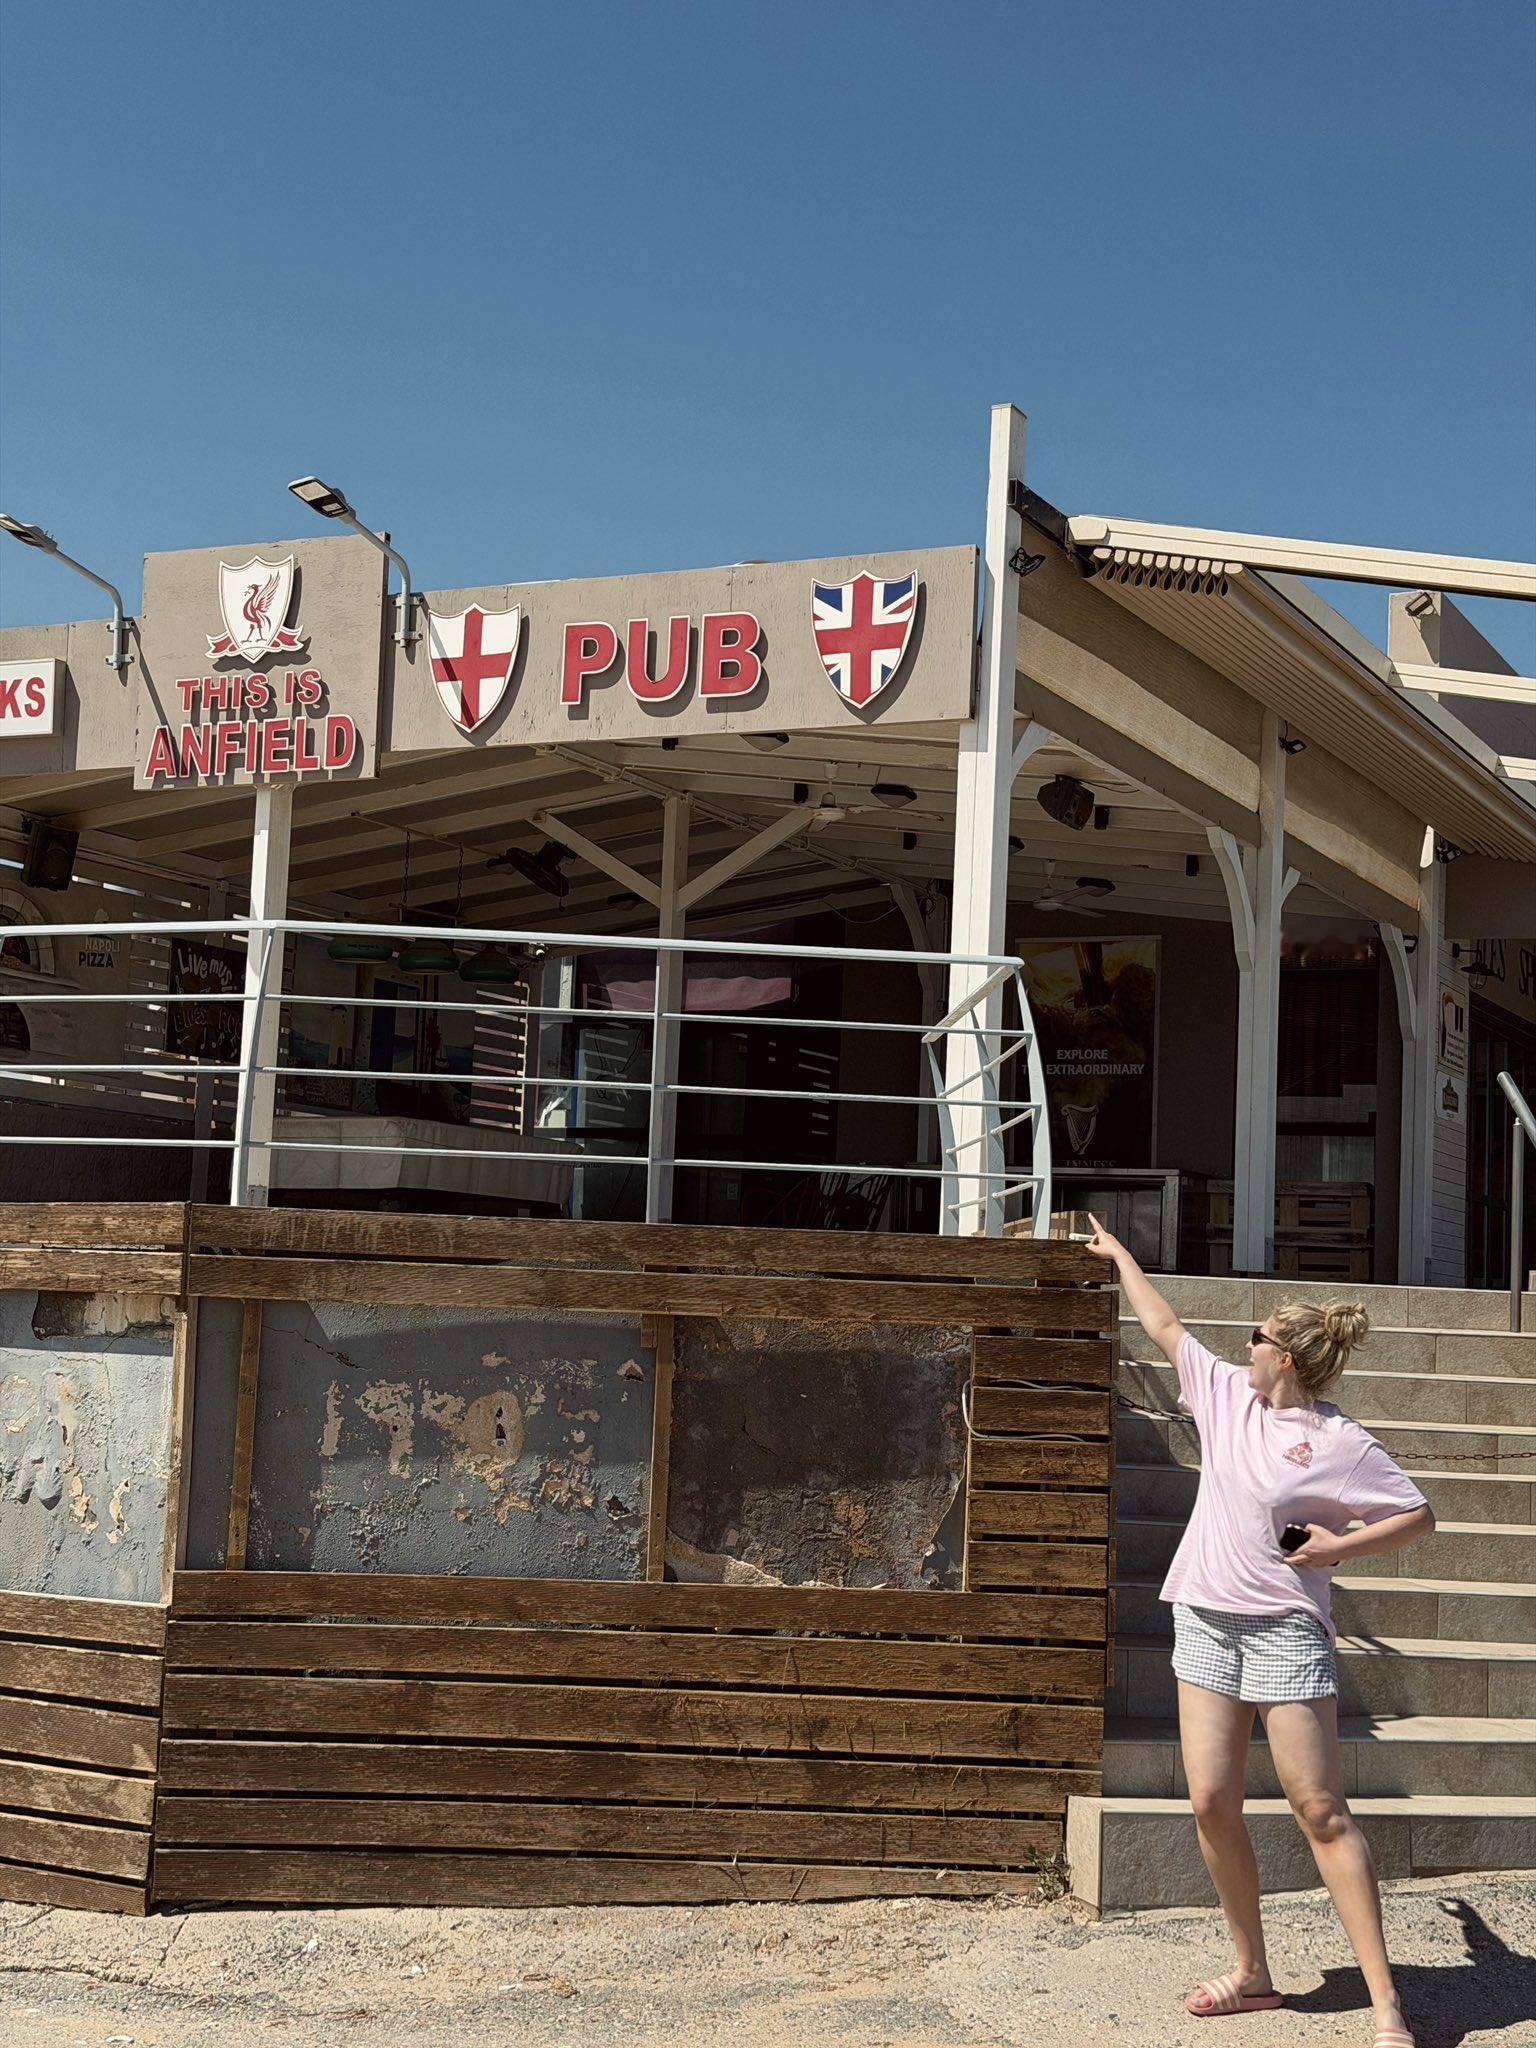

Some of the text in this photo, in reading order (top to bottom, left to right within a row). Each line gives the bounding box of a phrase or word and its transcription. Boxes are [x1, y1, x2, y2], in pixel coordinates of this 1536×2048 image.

[561, 611, 764, 706] PUB
[176, 669, 322, 711] THIS IS
[144, 714, 356, 779] ANFIELD
[79, 951, 114, 968] PIZZA
[85, 937, 120, 953] NAPOLI
[177, 947, 237, 992] Live musi
[1056, 1048, 1109, 1060] EXPLORE
[1046, 1063, 1145, 1076] EXTRAORDINARY
